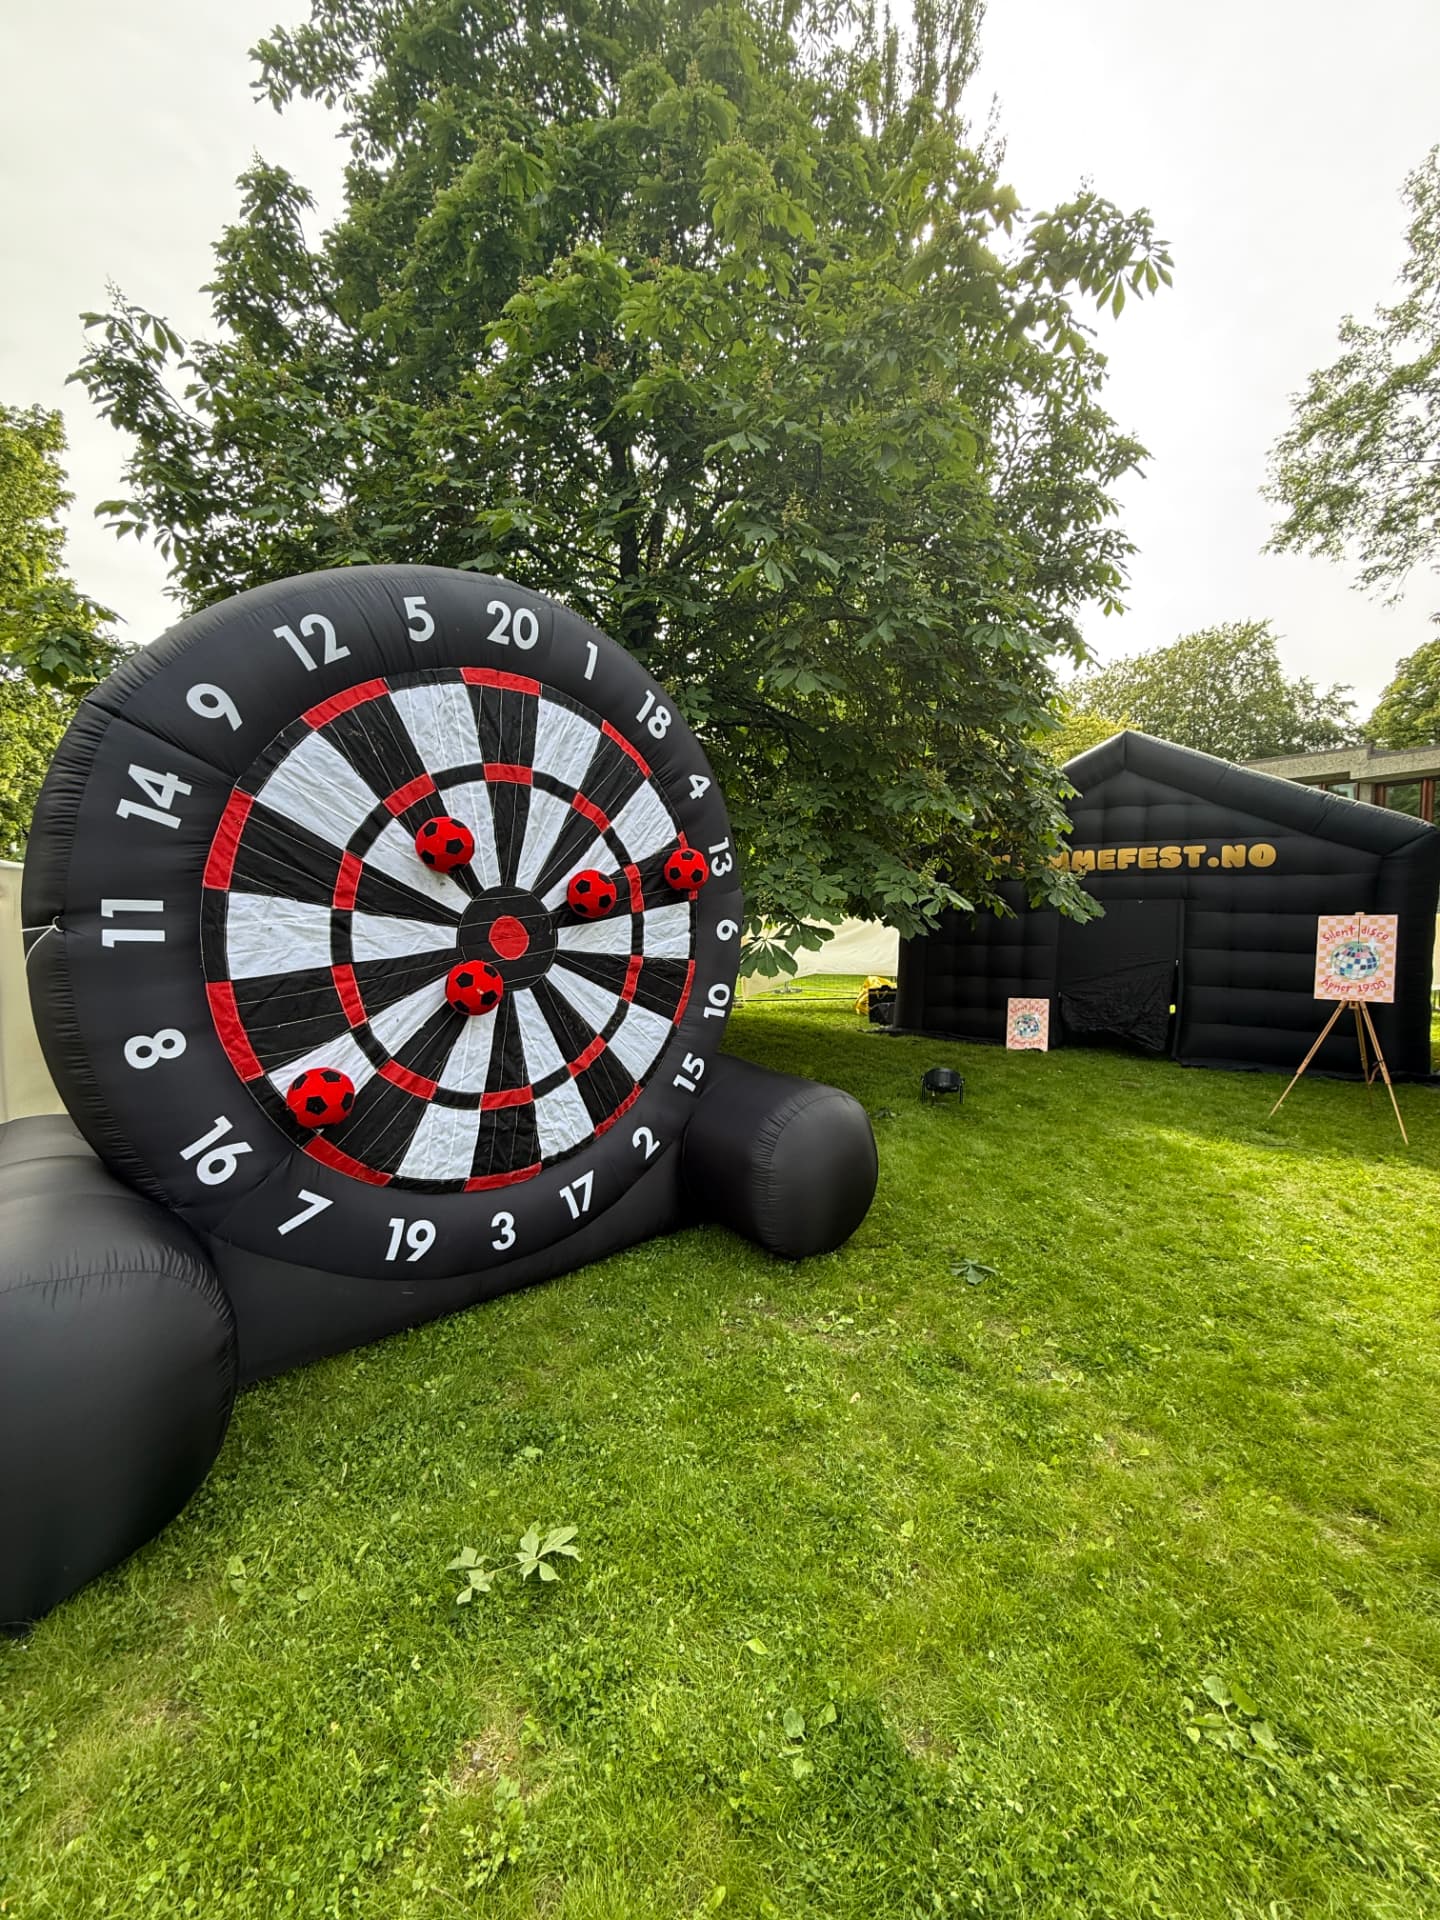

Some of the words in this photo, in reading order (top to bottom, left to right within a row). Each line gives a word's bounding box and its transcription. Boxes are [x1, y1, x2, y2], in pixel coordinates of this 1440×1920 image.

[403, 596, 434, 641] 5
[487, 600, 538, 649] 20
[273, 614, 350, 671] 12
[585, 641, 599, 681] 1
[186, 684, 243, 731] 9
[635, 690, 671, 740] 18
[117, 764, 193, 830] 14
[688, 775, 711, 800] 4
[708, 837, 733, 877] 13
[990, 843, 1277, 873] MMEFEST.NO
[101, 899, 166, 948] 11
[716, 919, 738, 941] 6
[1322, 925, 1355, 941] Silent
[1361, 926, 1389, 940] disco
[703, 983, 731, 1019] 10
[124, 1028, 187, 1070] 8
[673, 1053, 706, 1092] 15
[180, 1116, 253, 1186] 16
[631, 1126, 660, 1160] 2
[278, 1189, 334, 1236] 7
[559, 1170, 595, 1220] 17
[385, 1218, 436, 1262] 19
[492, 1212, 516, 1251] 3
